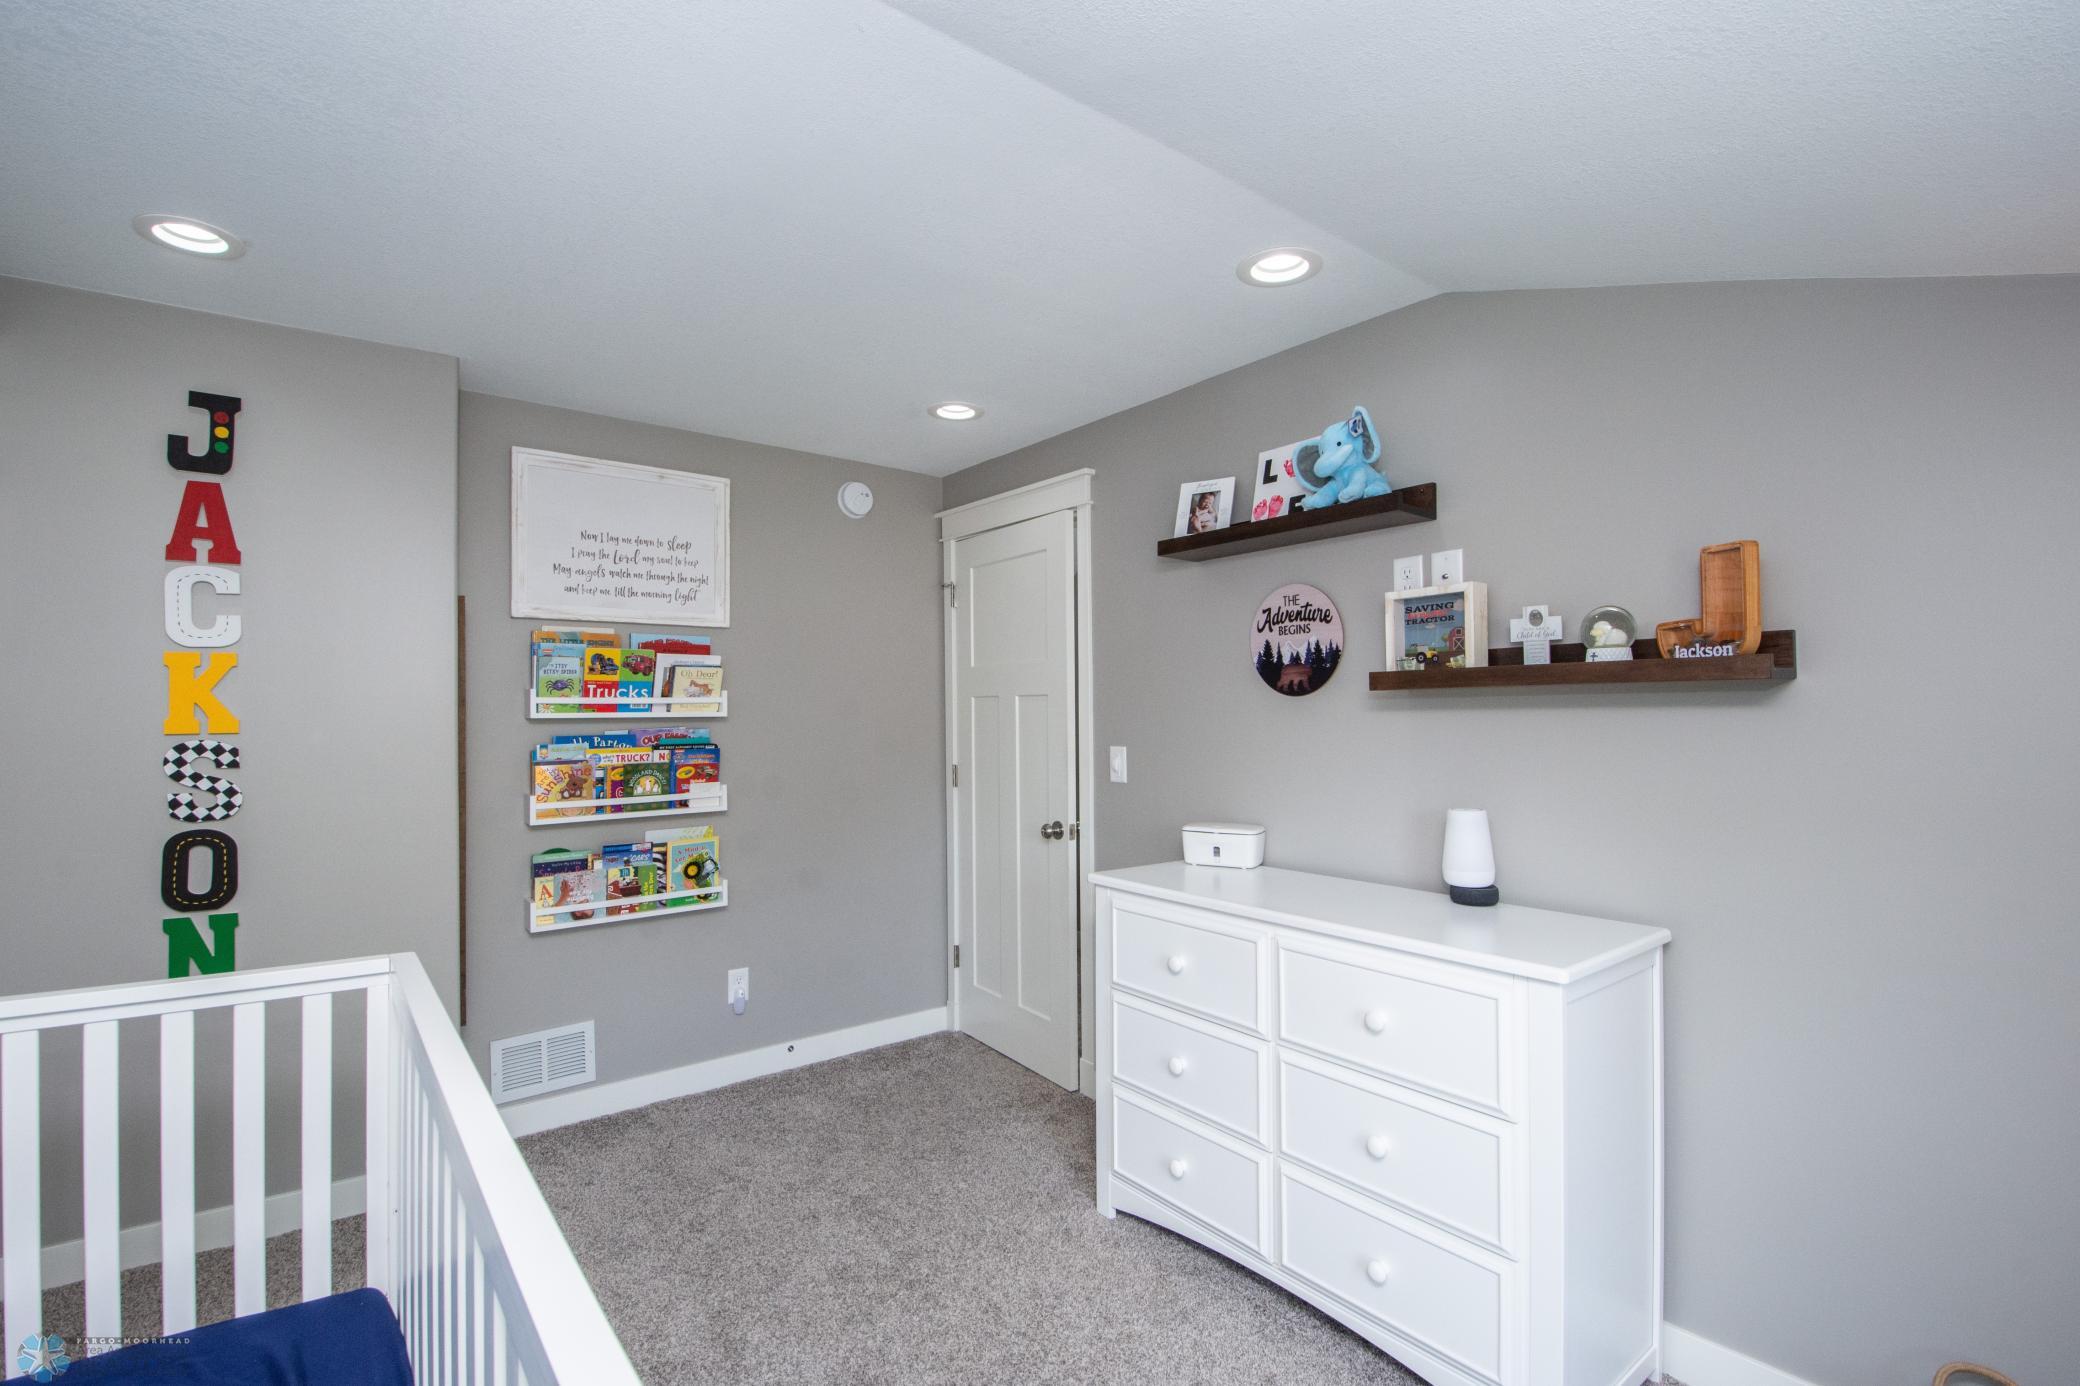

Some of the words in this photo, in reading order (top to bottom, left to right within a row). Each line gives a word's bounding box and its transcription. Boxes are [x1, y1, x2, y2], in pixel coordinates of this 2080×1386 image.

[581, 530, 599, 542] Now
[601, 532, 604, 543] I
[607, 532, 619, 546] lay
[634, 536, 655, 547] down
[657, 538, 664, 548] to
[578, 549, 596, 561] pray
[599, 548, 610, 560] the
[614, 549, 641, 565] Lord
[642, 556, 655, 566] my
[656, 555, 673, 566] soul
[675, 556, 682, 567] to
[684, 556, 699, 568] keep
[553, 562, 572, 578] May
[574, 564, 606, 582] angels
[608, 568, 631, 579] watch
[646, 569, 675, 586] through
[677, 571, 688, 583] the
[690, 573, 709, 588] night
[564, 583, 580, 595] and
[581, 583, 598, 596] keep
[599, 588, 611, 596] me
[614, 586, 626, 598] till
[627, 586, 639, 598] the
[640, 591, 672, 603] morning
[674, 587, 698, 606] light
[1283, 594, 1300, 606] THE
[1405, 602, 1455, 614] SAVING
[1257, 602, 1333, 633] Adventure
[1405, 614, 1455, 626] TRACTOR
[1278, 623, 1311, 636] BEGINS
[696, 670, 719, 678] Dear!
[161, 390, 244, 979] JACKSON
[587, 684, 648, 697] Trucks
[615, 754, 650, 763] TRUCK?
